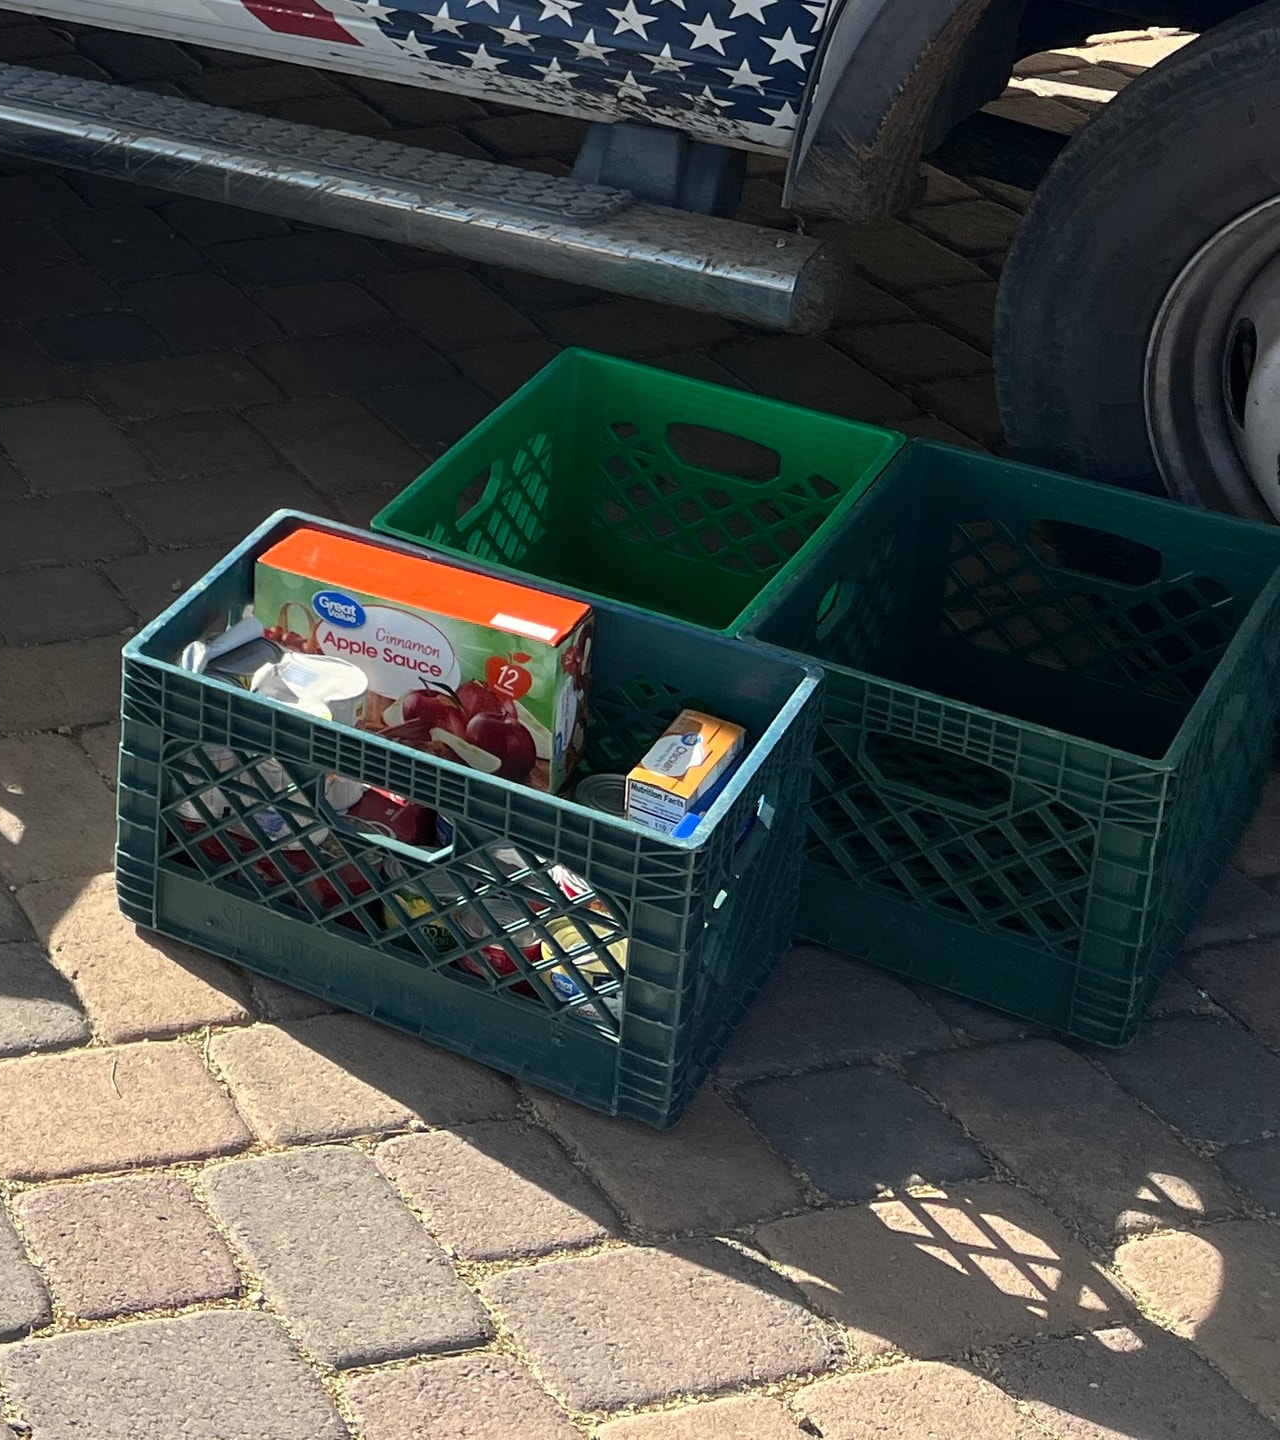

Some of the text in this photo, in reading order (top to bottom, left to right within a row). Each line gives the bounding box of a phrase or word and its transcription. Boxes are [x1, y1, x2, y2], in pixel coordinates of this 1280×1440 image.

[317, 595, 357, 617] Great
[327, 608, 357, 624] Value
[323, 630, 443, 678] Apple Sauce
[375, 626, 441, 659] Cinnamon
[497, 665, 520, 691] 12
[661, 745, 688, 772] Chicken
[631, 781, 684, 808] Nutrition Facts
